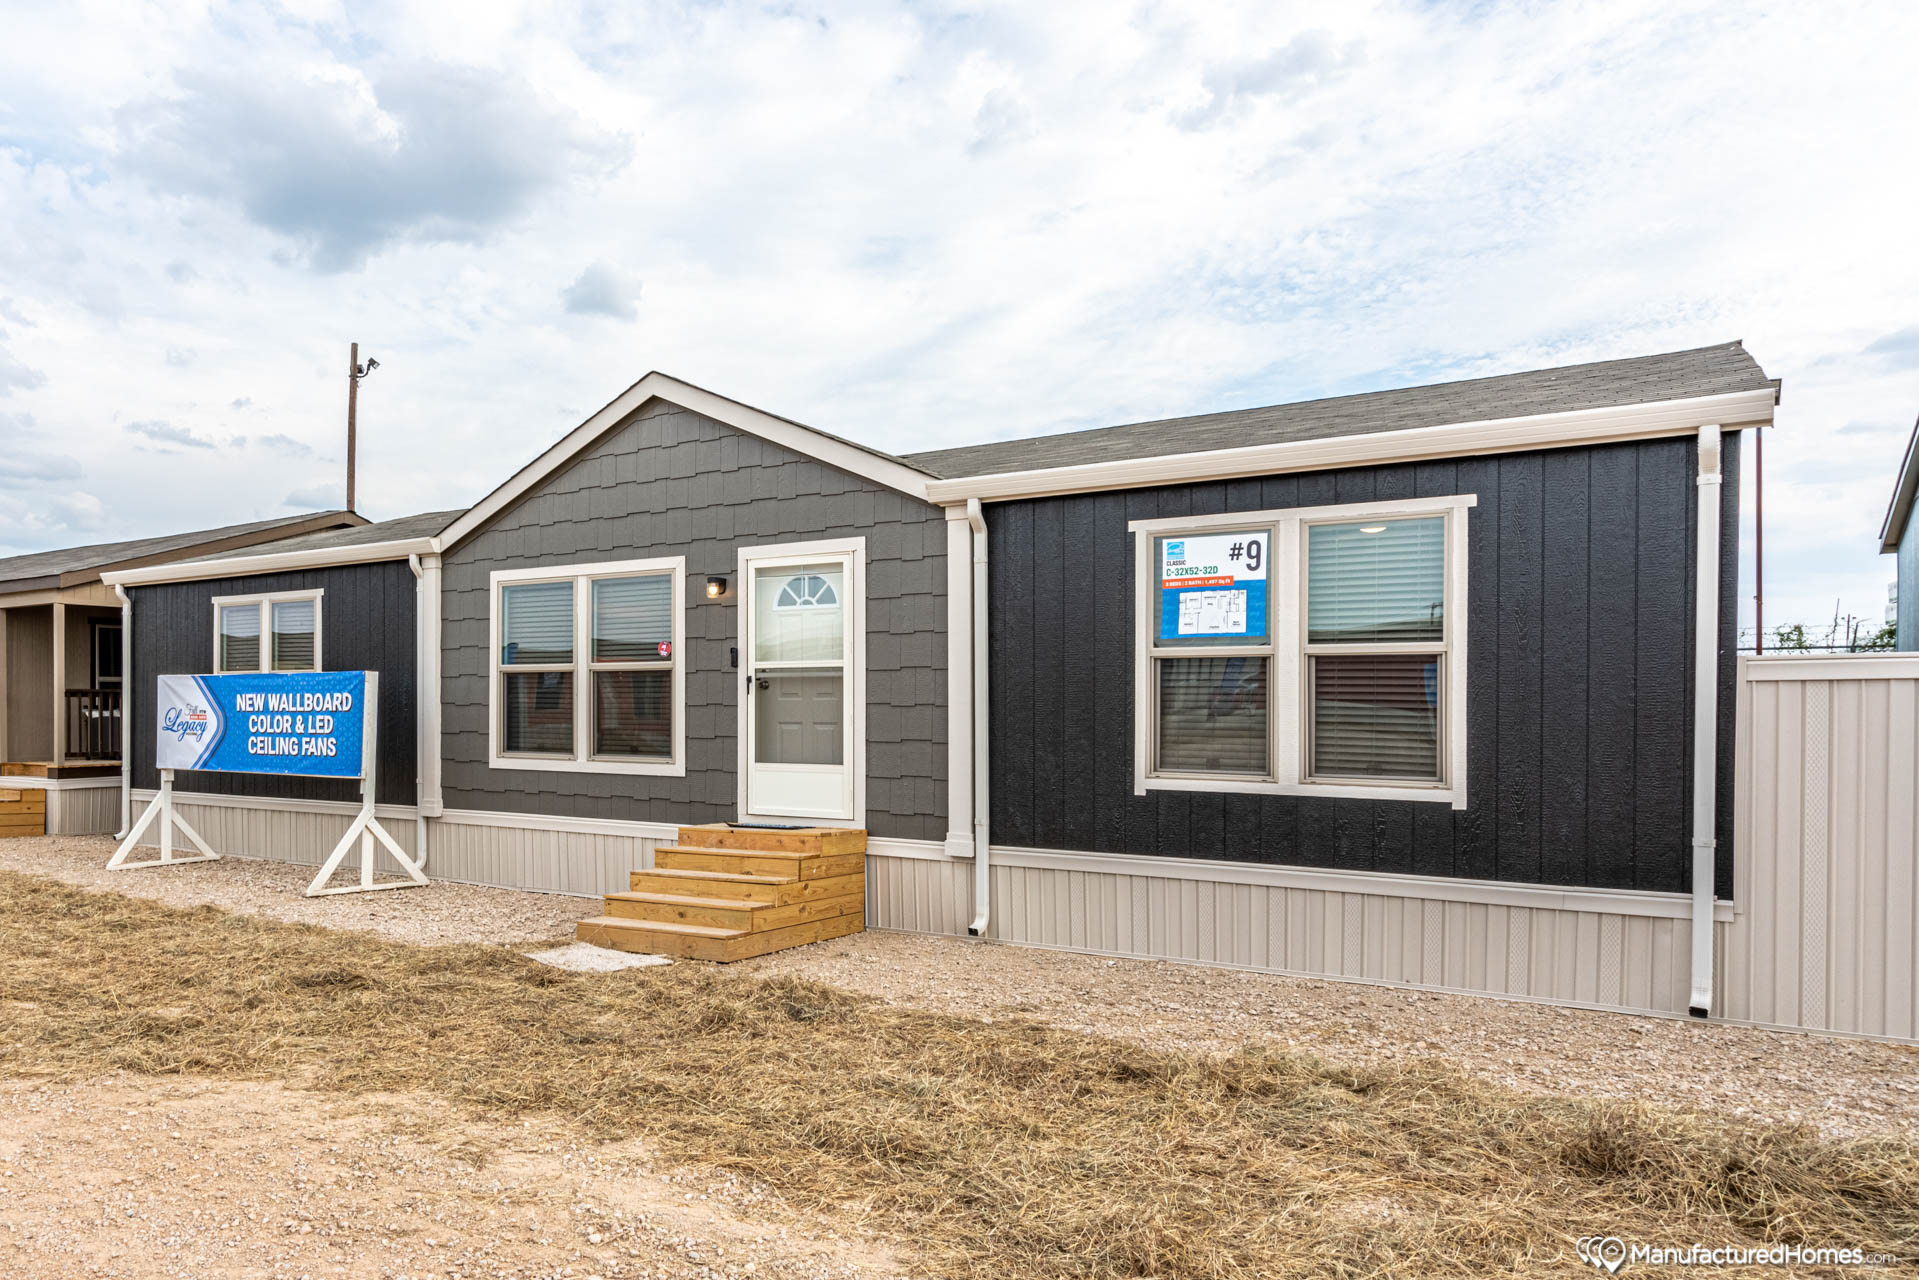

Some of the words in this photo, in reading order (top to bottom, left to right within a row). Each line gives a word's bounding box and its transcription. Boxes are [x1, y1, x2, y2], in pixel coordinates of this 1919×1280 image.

[1229, 540, 1261, 571] #9
[1166, 565, 1218, 577] C-32X52-32D
[236, 694, 265, 712] NEW
[268, 693, 352, 711] WALLBOARD
[162, 706, 207, 742] Legacy
[248, 715, 293, 734] COLOR
[295, 715, 305, 734] &
[308, 715, 334, 734] LED
[248, 737, 299, 756] CEILING
[301, 737, 337, 757] FANS
